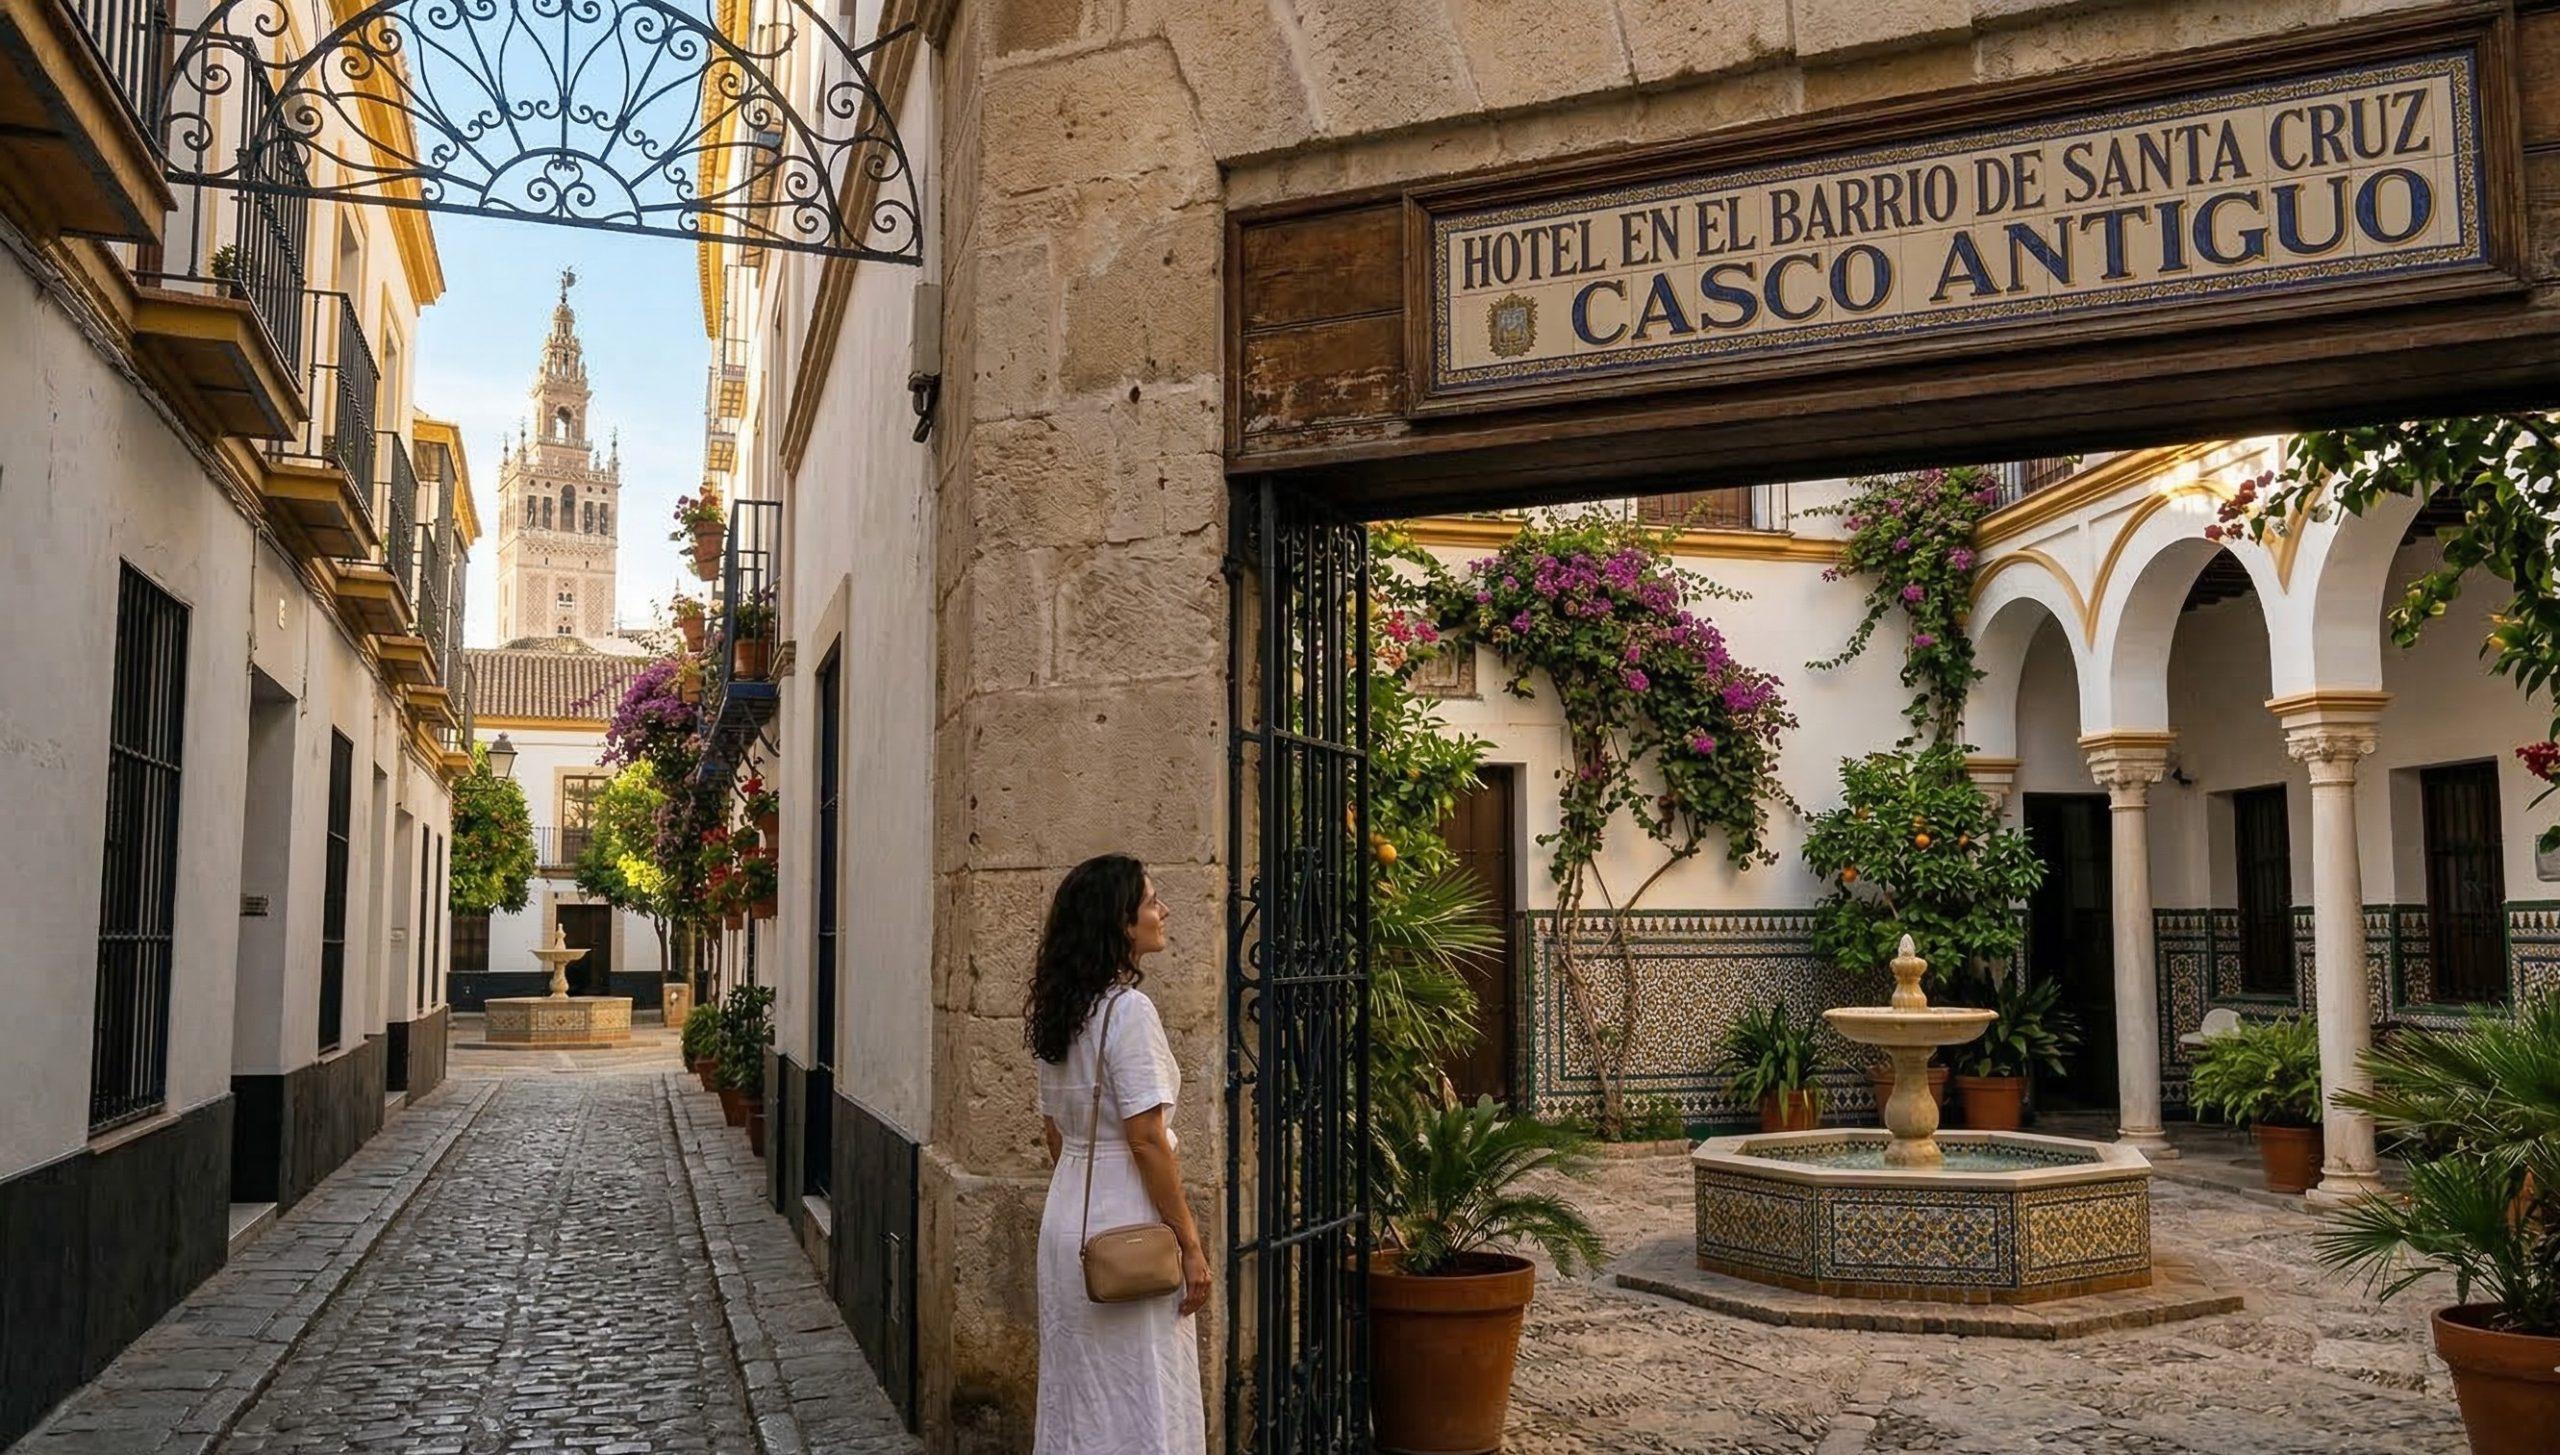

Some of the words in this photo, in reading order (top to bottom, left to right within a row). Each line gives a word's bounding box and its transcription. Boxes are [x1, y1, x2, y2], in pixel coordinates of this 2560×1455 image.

[1462, 219, 1606, 290] HOTEL
[1620, 205, 1681, 267] EN
[1695, 195, 1757, 257] EL
[1769, 164, 1958, 246] BARRIO
[1974, 149, 2046, 217] DE
[2063, 119, 2252, 203] SANTA
[2269, 88, 2430, 172] CRUZ
[1572, 244, 1894, 346] CASCO
[1928, 167, 2433, 302] ANTIGUO
